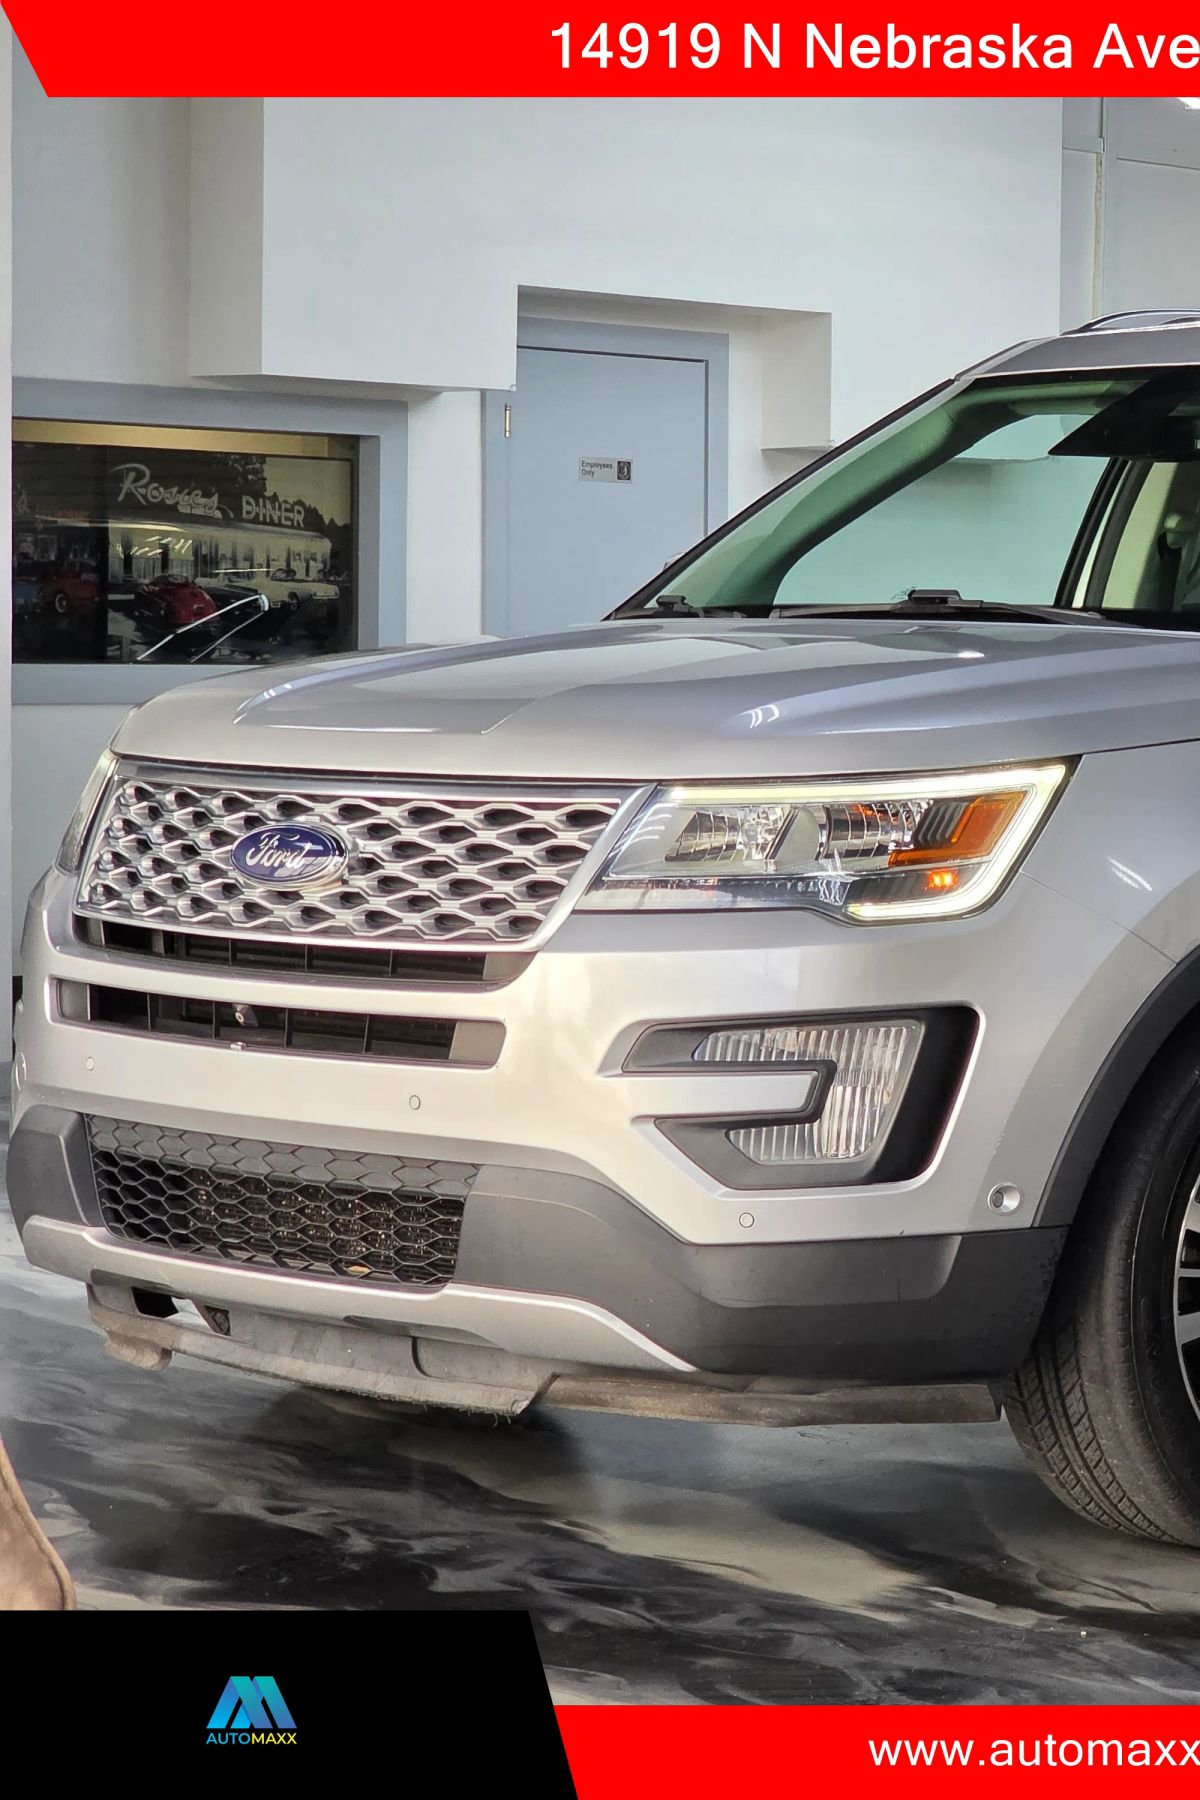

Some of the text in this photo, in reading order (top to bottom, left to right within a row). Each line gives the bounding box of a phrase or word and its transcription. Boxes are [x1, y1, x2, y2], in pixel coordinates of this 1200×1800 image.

[581, 460, 613, 470] Employees
[581, 468, 595, 477] Only
[242, 495, 305, 528] DINER
[246, 831, 324, 869] Ford
